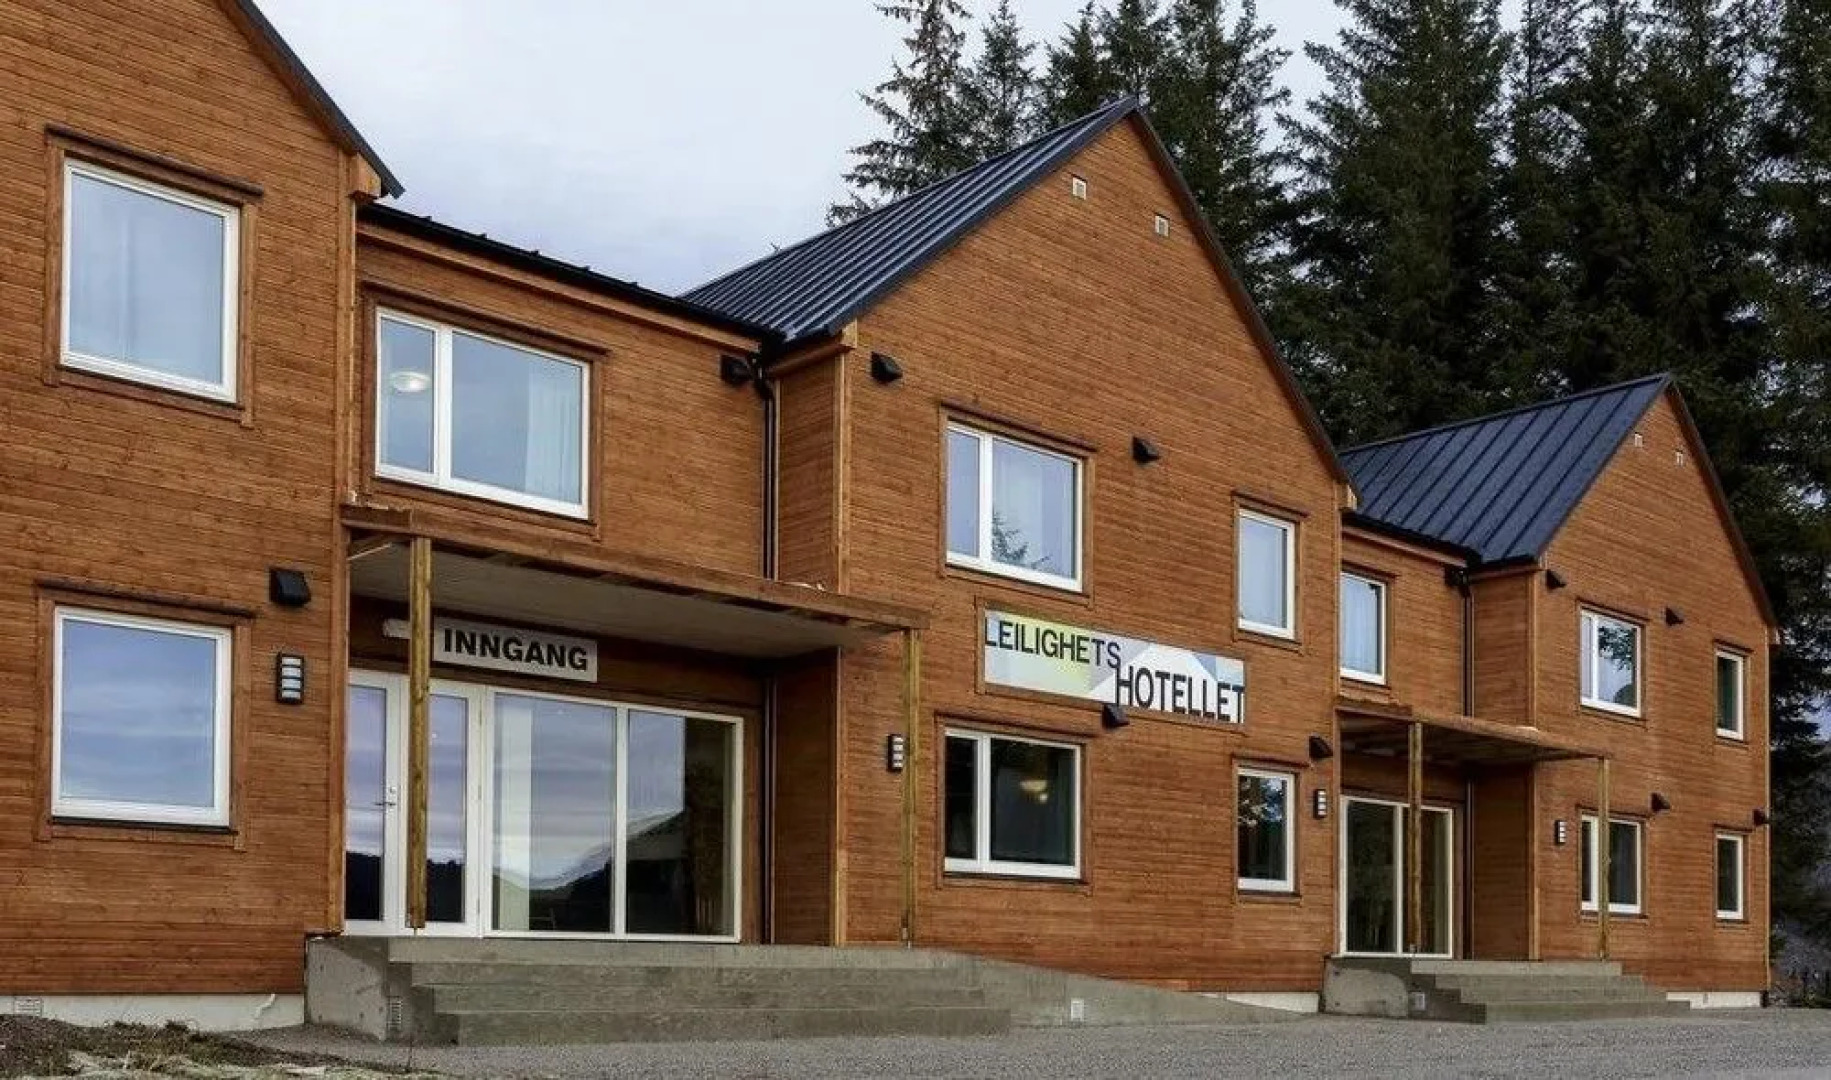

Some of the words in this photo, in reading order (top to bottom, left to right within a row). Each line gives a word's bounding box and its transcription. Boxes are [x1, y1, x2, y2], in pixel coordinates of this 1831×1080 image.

[443, 628, 588, 671] INNGANG
[984, 616, 1121, 669] LEILIGHETS
[1115, 665, 1244, 723] HOTELLET
